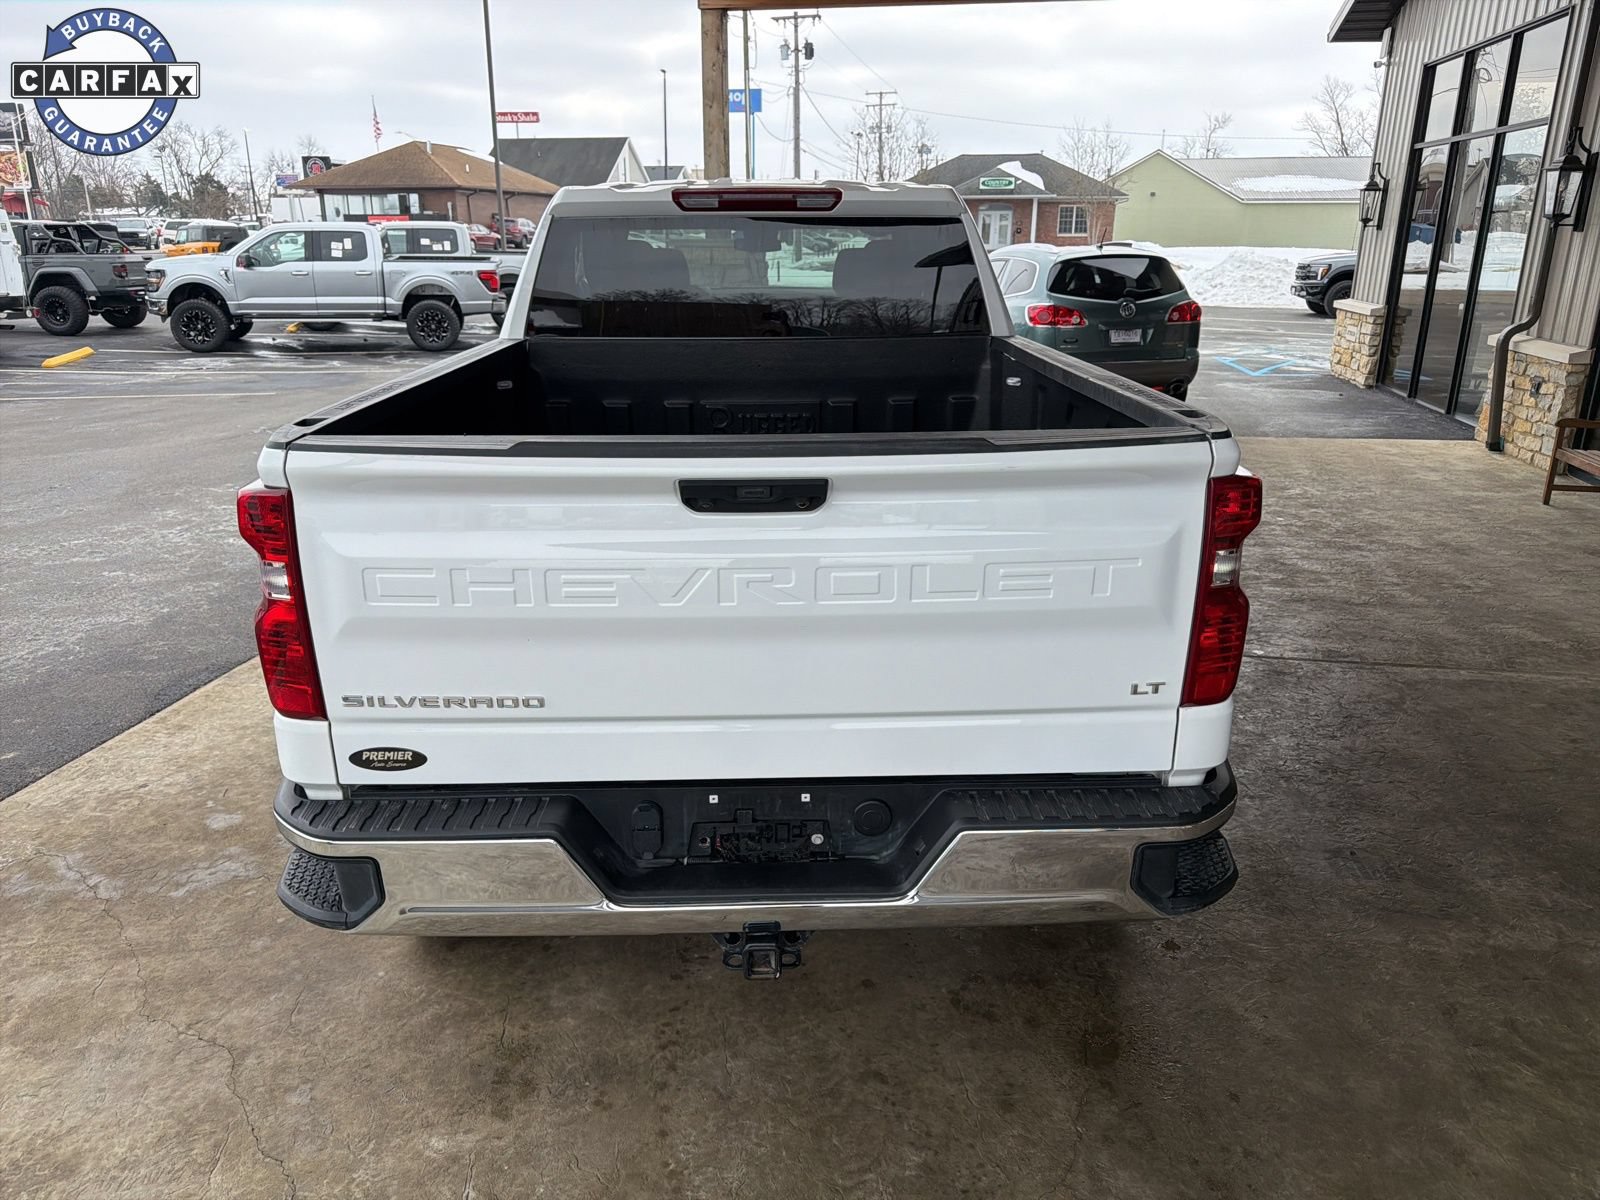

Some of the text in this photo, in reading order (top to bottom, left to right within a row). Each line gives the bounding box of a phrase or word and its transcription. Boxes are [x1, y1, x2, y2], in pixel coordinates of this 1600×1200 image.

[362, 557, 1143, 608] CHEVROLET
[1130, 681, 1166, 696] LT
[341, 694, 546, 709] SILVERADO
[362, 751, 413, 761] PREMIER
